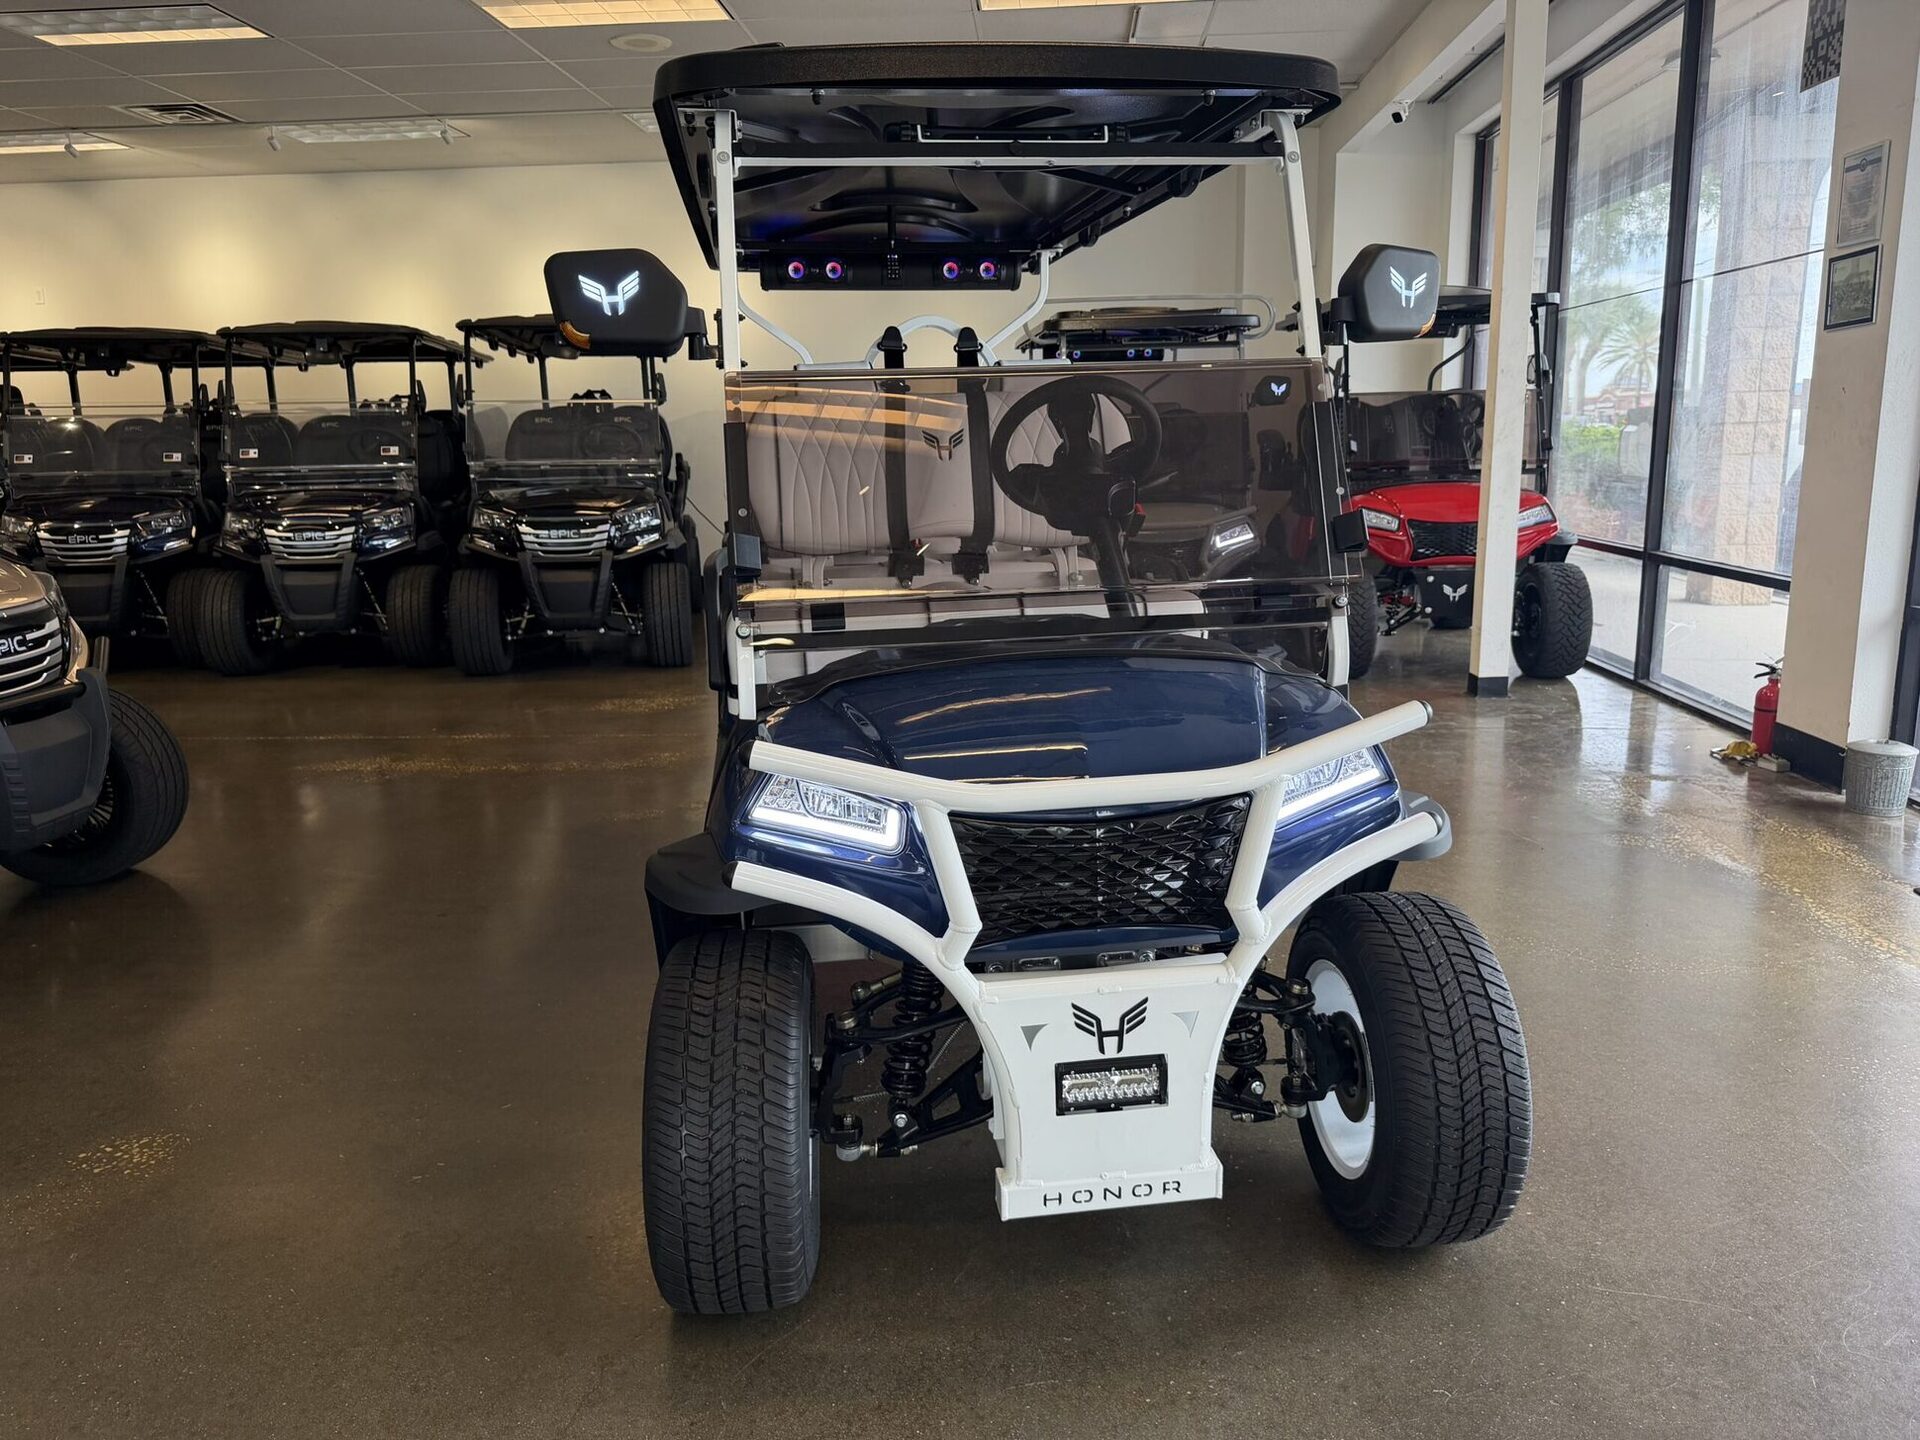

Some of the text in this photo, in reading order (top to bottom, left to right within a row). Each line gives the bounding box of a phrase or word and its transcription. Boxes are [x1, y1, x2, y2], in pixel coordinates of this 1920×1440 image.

[68, 534, 98, 544] EPIC
[294, 531, 324, 541] EPIC
[550, 529, 579, 539] EPIC
[0, 635, 27, 656] PIC
[1043, 1180, 1182, 1208] HONOR
